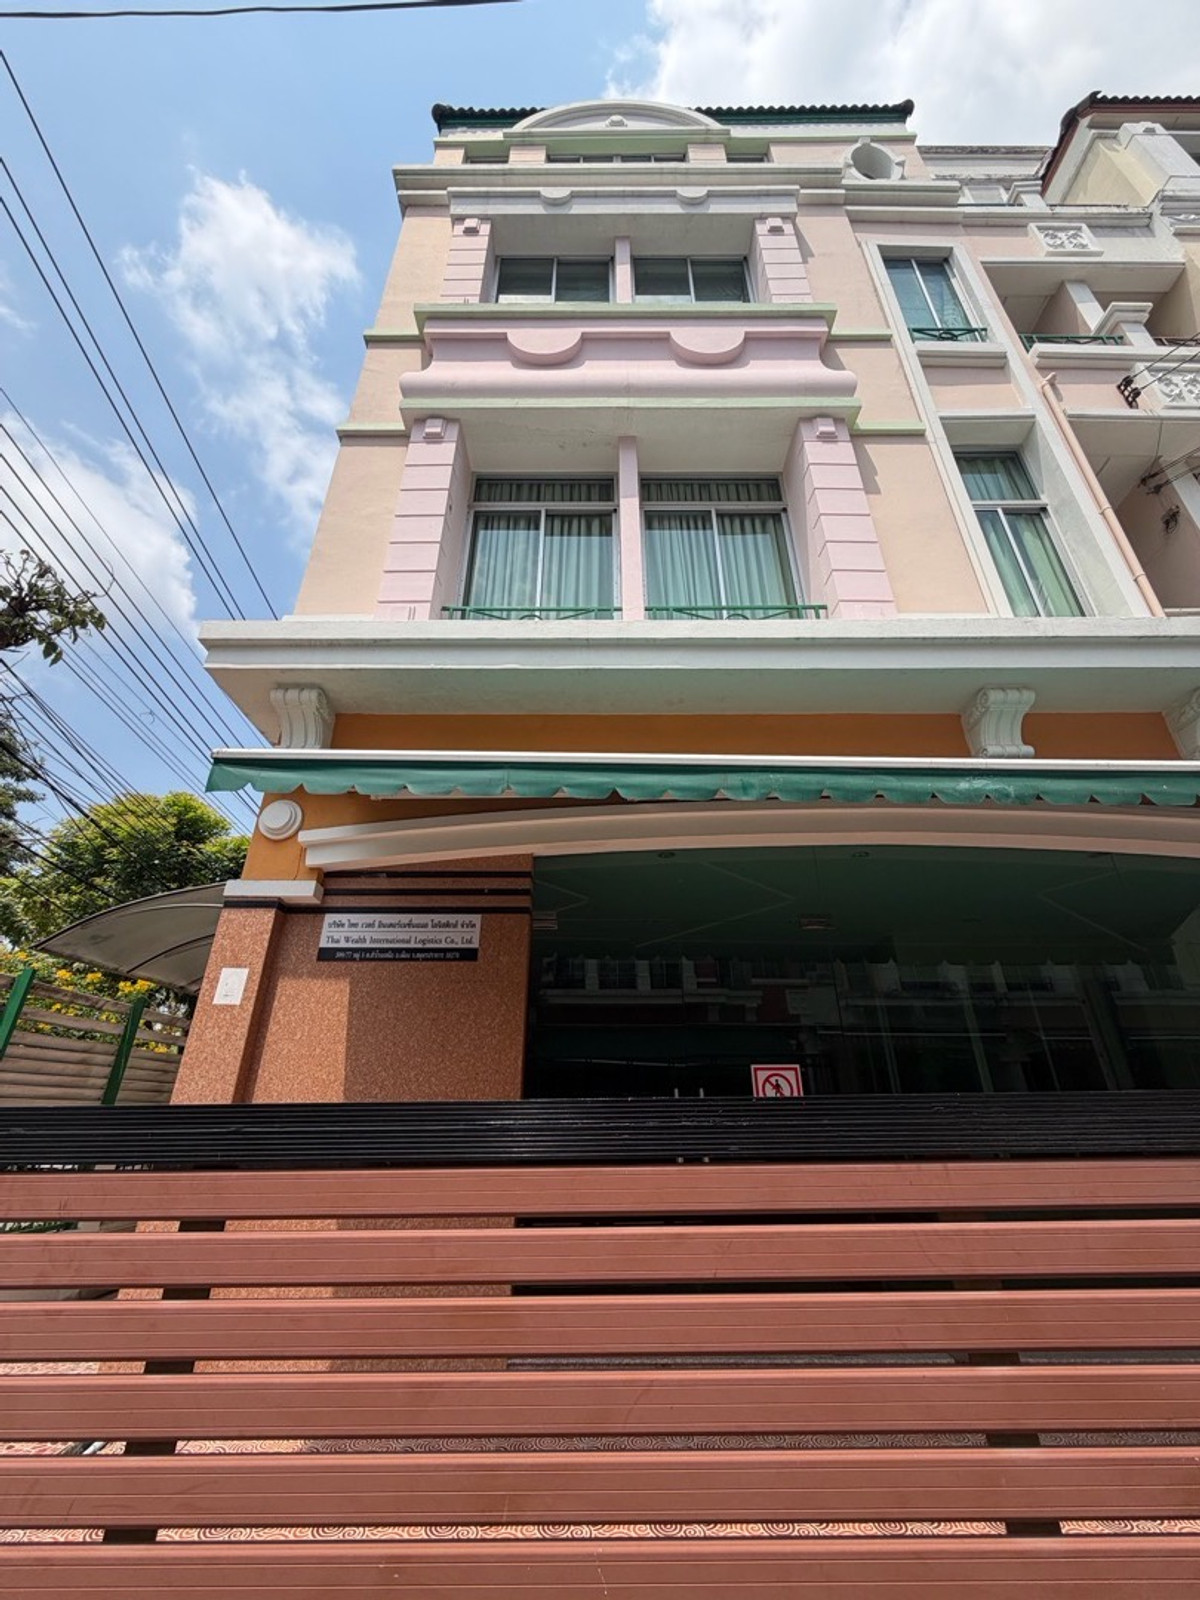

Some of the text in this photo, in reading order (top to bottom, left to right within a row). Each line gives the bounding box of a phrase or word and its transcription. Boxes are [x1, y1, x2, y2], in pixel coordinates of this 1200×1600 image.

[327, 919, 345, 929] บริษัท
[347, 918, 360, 929] ไทย
[460, 919, 477, 929] จำกัด
[326, 935, 341, 945] Thai
[343, 935, 367, 945] Wealth
[369, 935, 411, 945] International
[413, 935, 443, 947] Logistics
[460, 935, 475, 945] Ltd.
